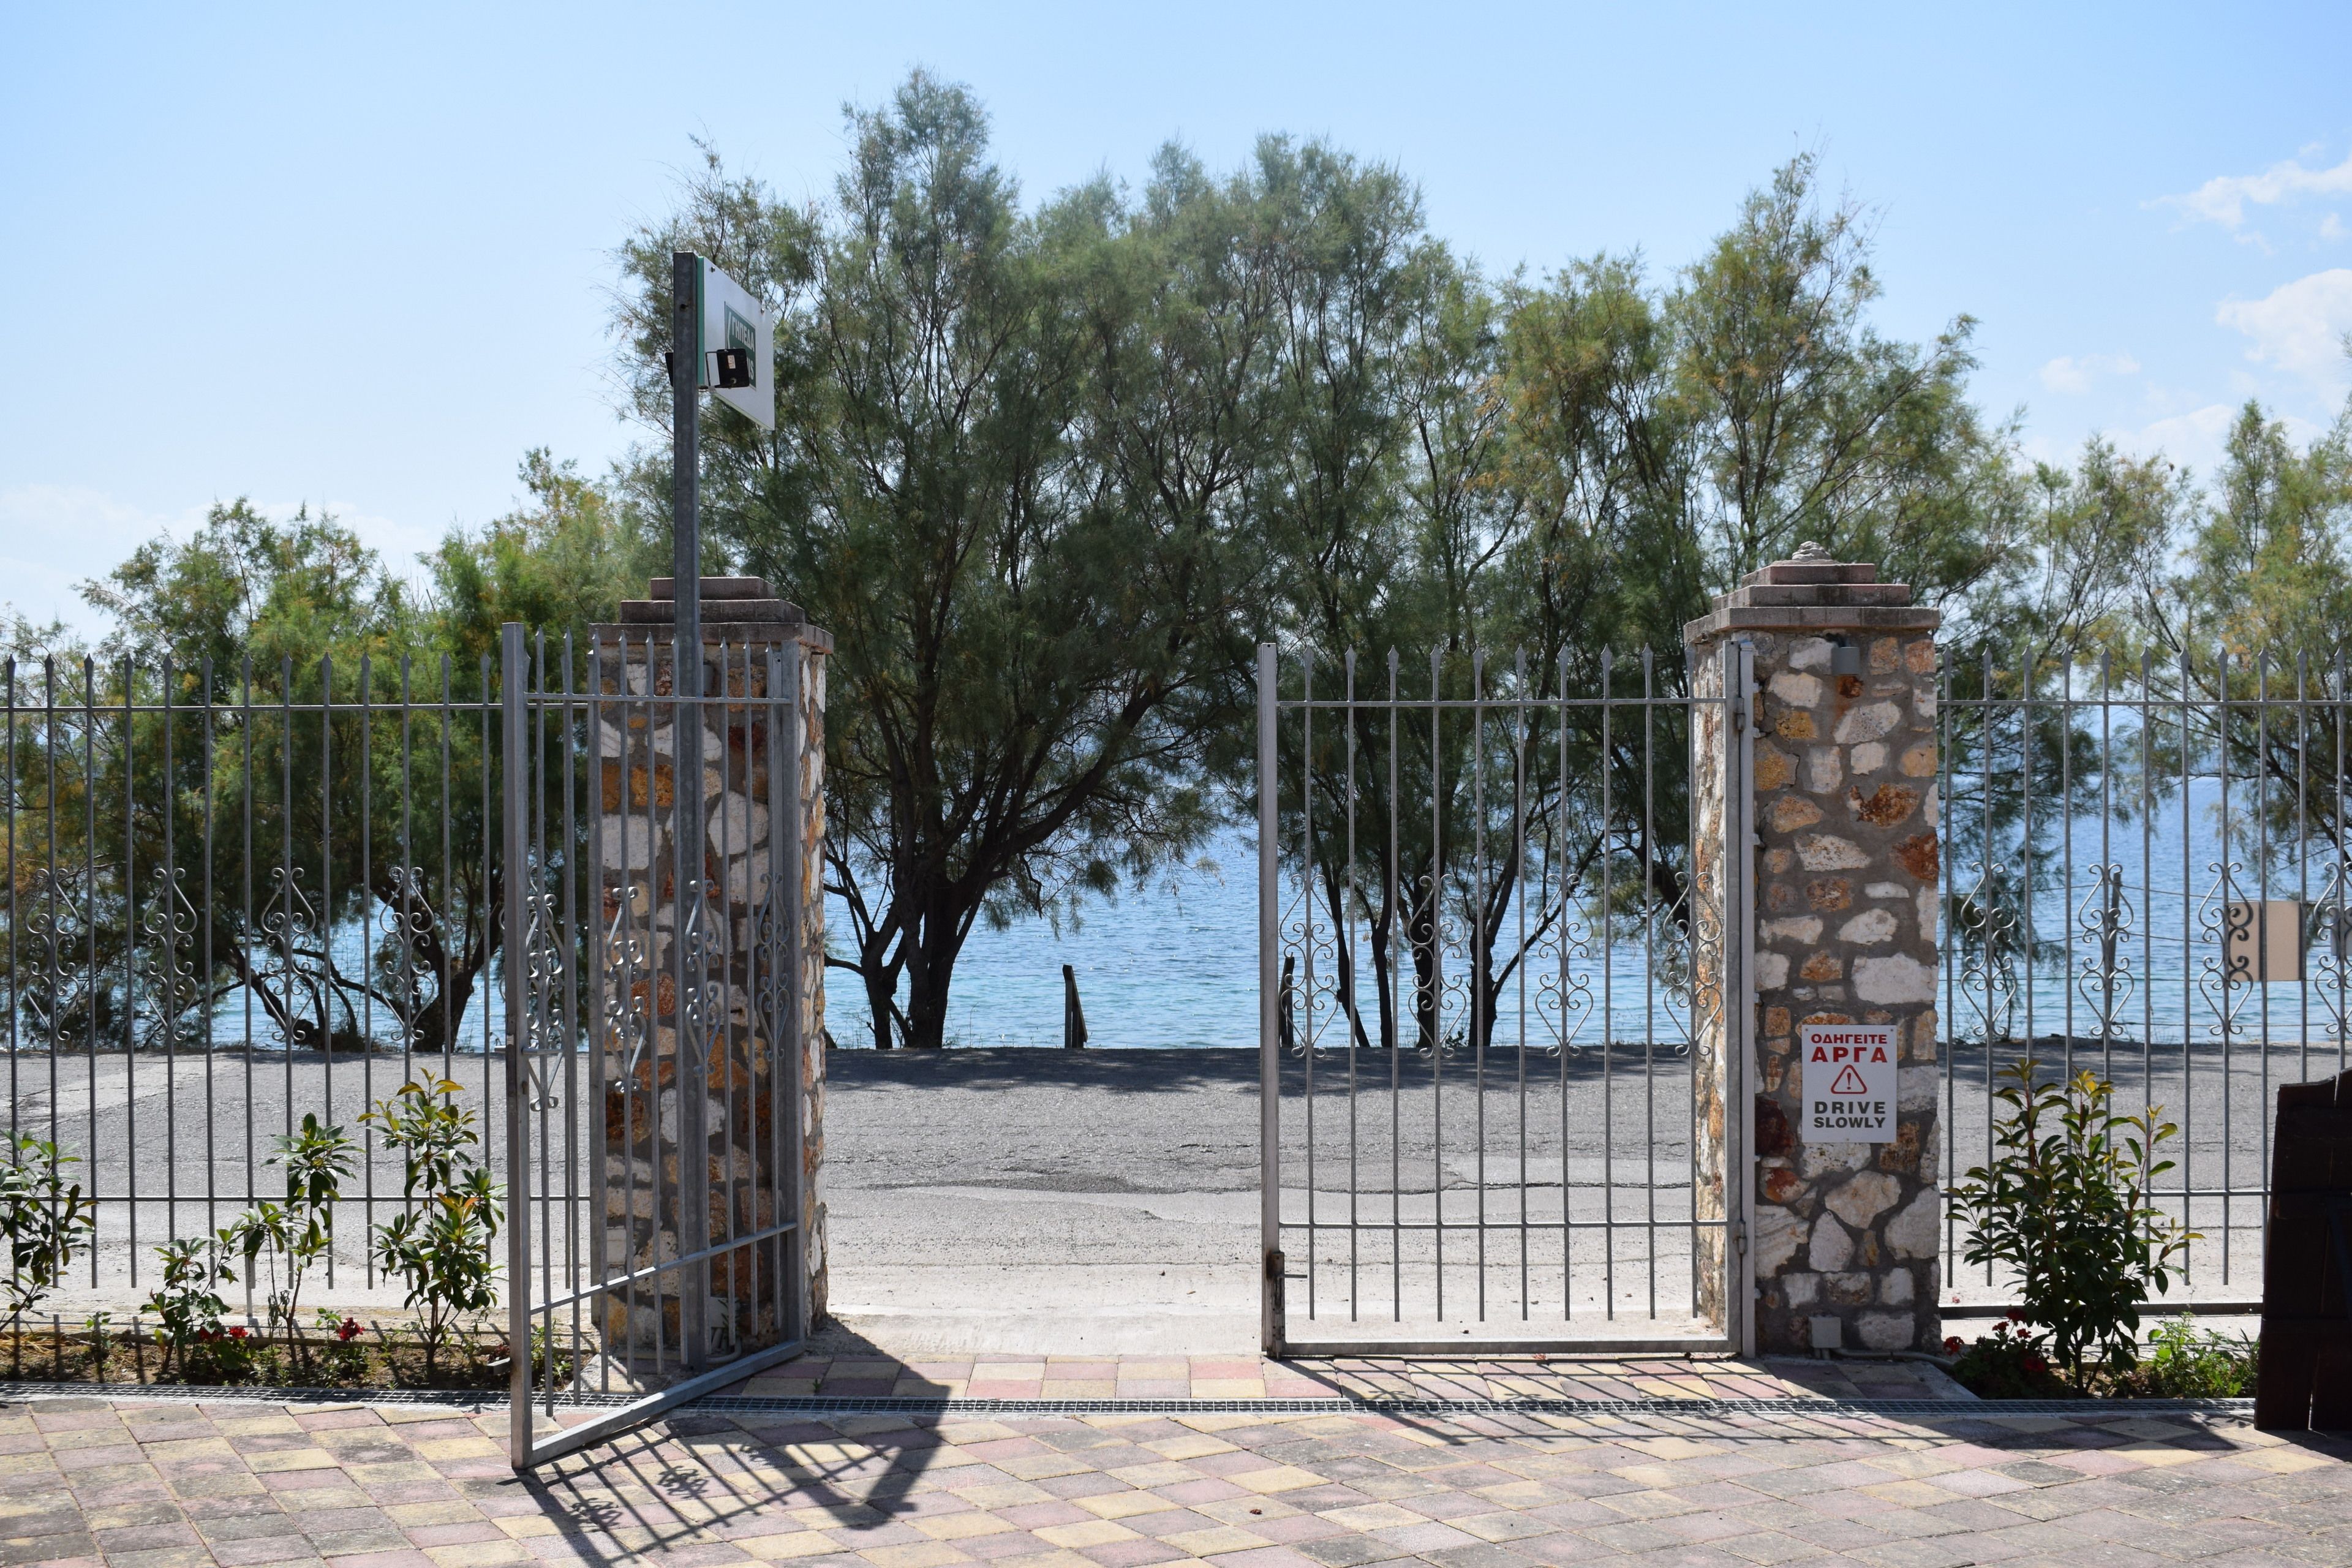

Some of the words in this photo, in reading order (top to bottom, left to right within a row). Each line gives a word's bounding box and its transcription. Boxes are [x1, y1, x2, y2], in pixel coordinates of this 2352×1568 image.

[732, 315, 755, 352] ΓΗΠΕΔΑ
[1811, 1034, 1887, 1044] ΟΔΗΓΕΙΤΕ
[1811, 1047, 1887, 1063] ΑΡΓΑ
[1815, 1102, 1885, 1114] DRIVE
[1814, 1117, 1885, 1128] SLOWLY
